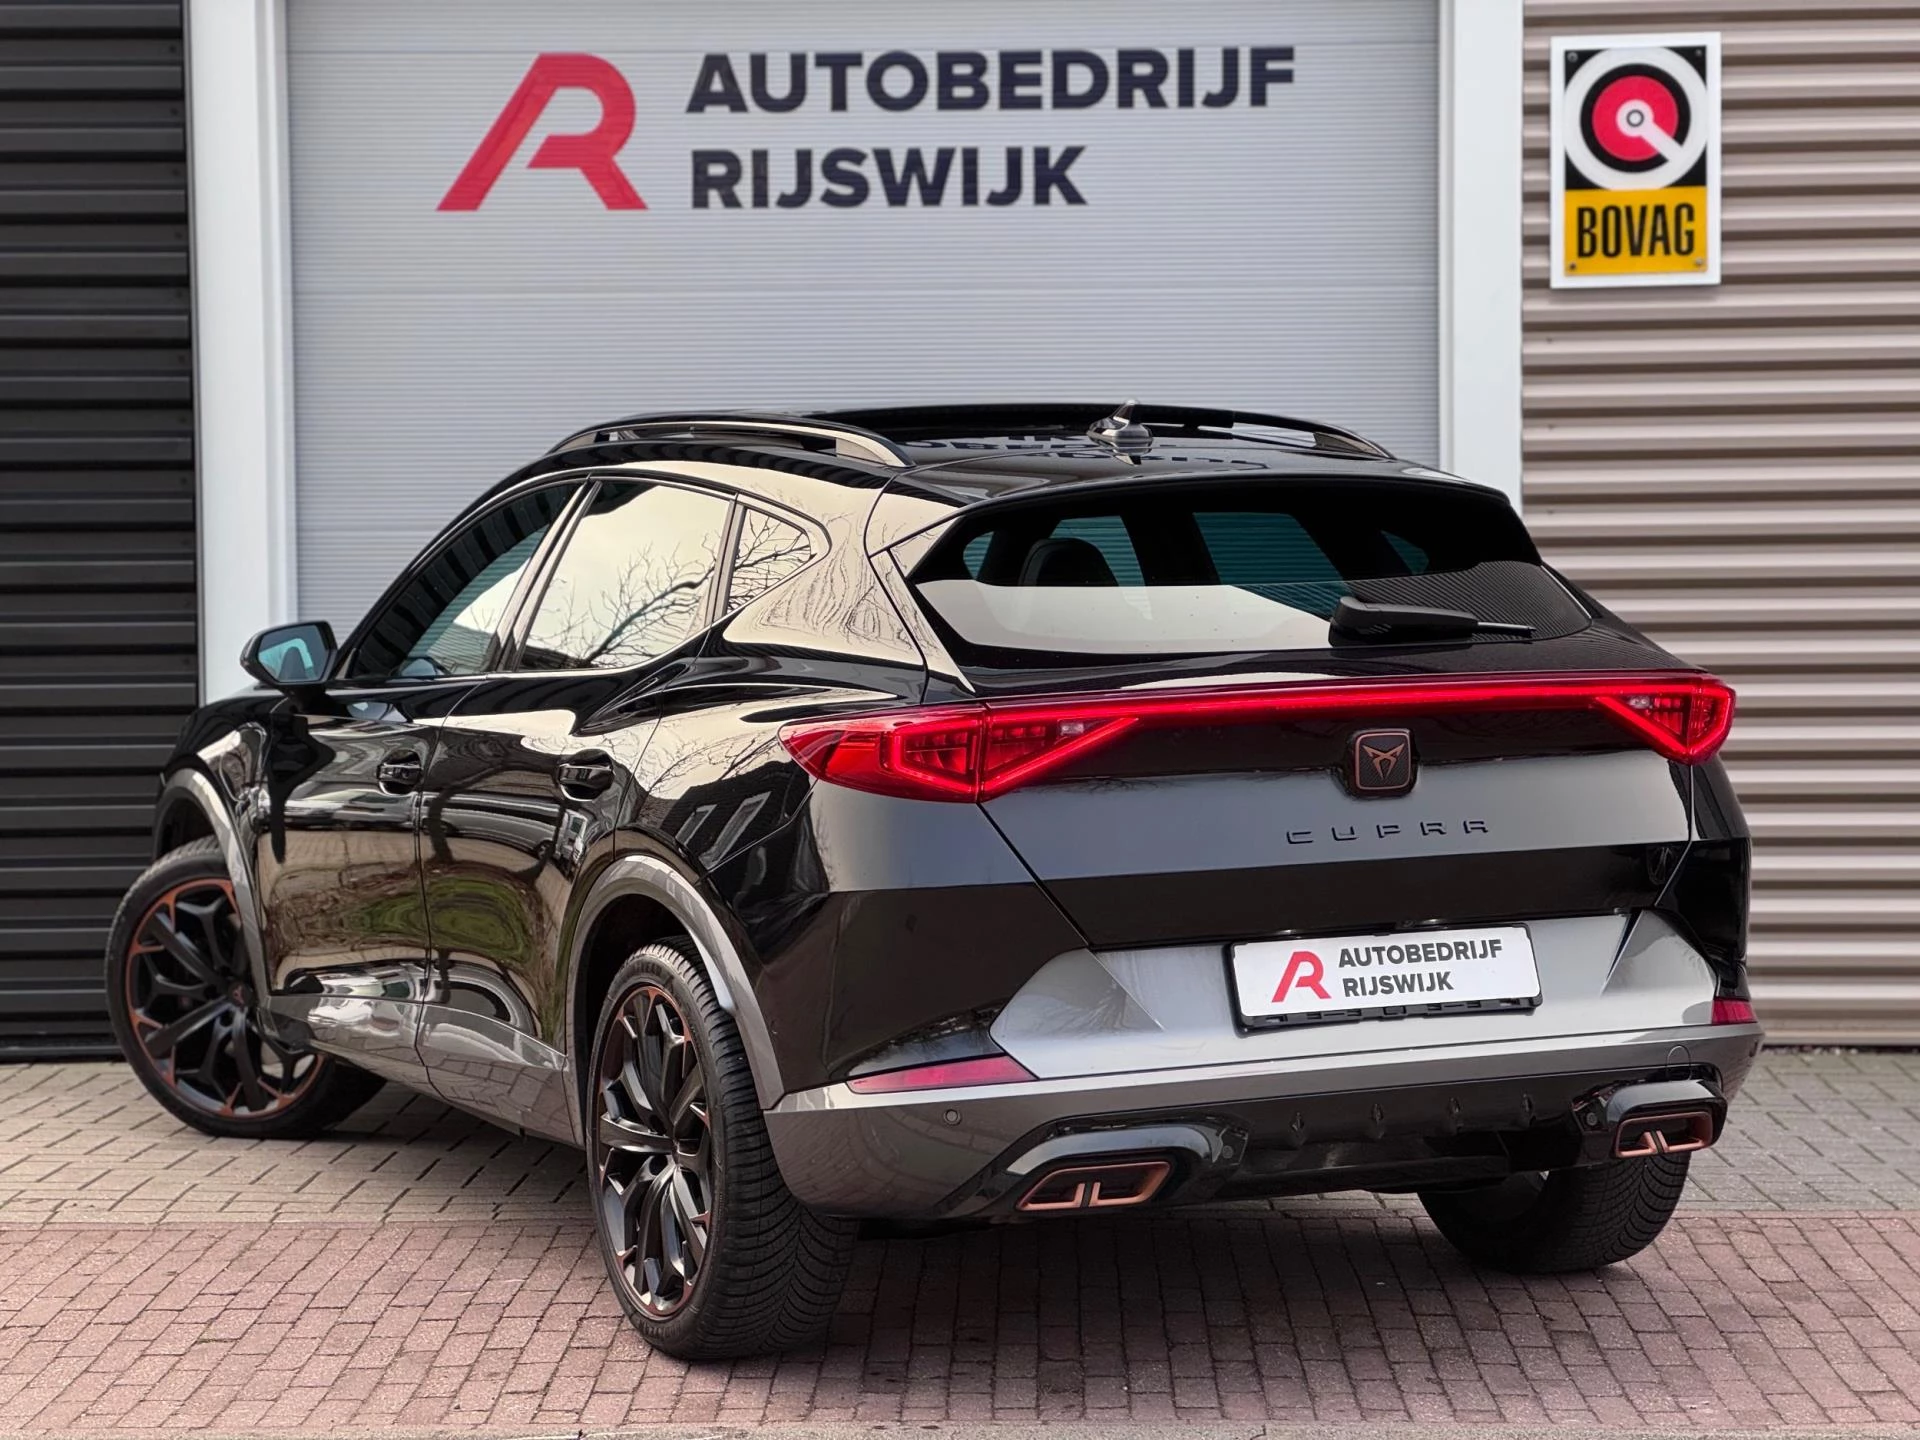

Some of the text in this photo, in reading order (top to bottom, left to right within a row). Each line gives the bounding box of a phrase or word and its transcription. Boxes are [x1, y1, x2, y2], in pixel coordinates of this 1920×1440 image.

[685, 46, 1295, 114] AUTOBEDRIJF
[690, 145, 1088, 209] RIJSWIJK
[1576, 202, 1695, 259] BOVAG
[1286, 819, 1489, 845] CUPRA
[1338, 938, 1503, 968] AUTOBEDRIJF
[1342, 970, 1454, 998] RIJSWIJK
